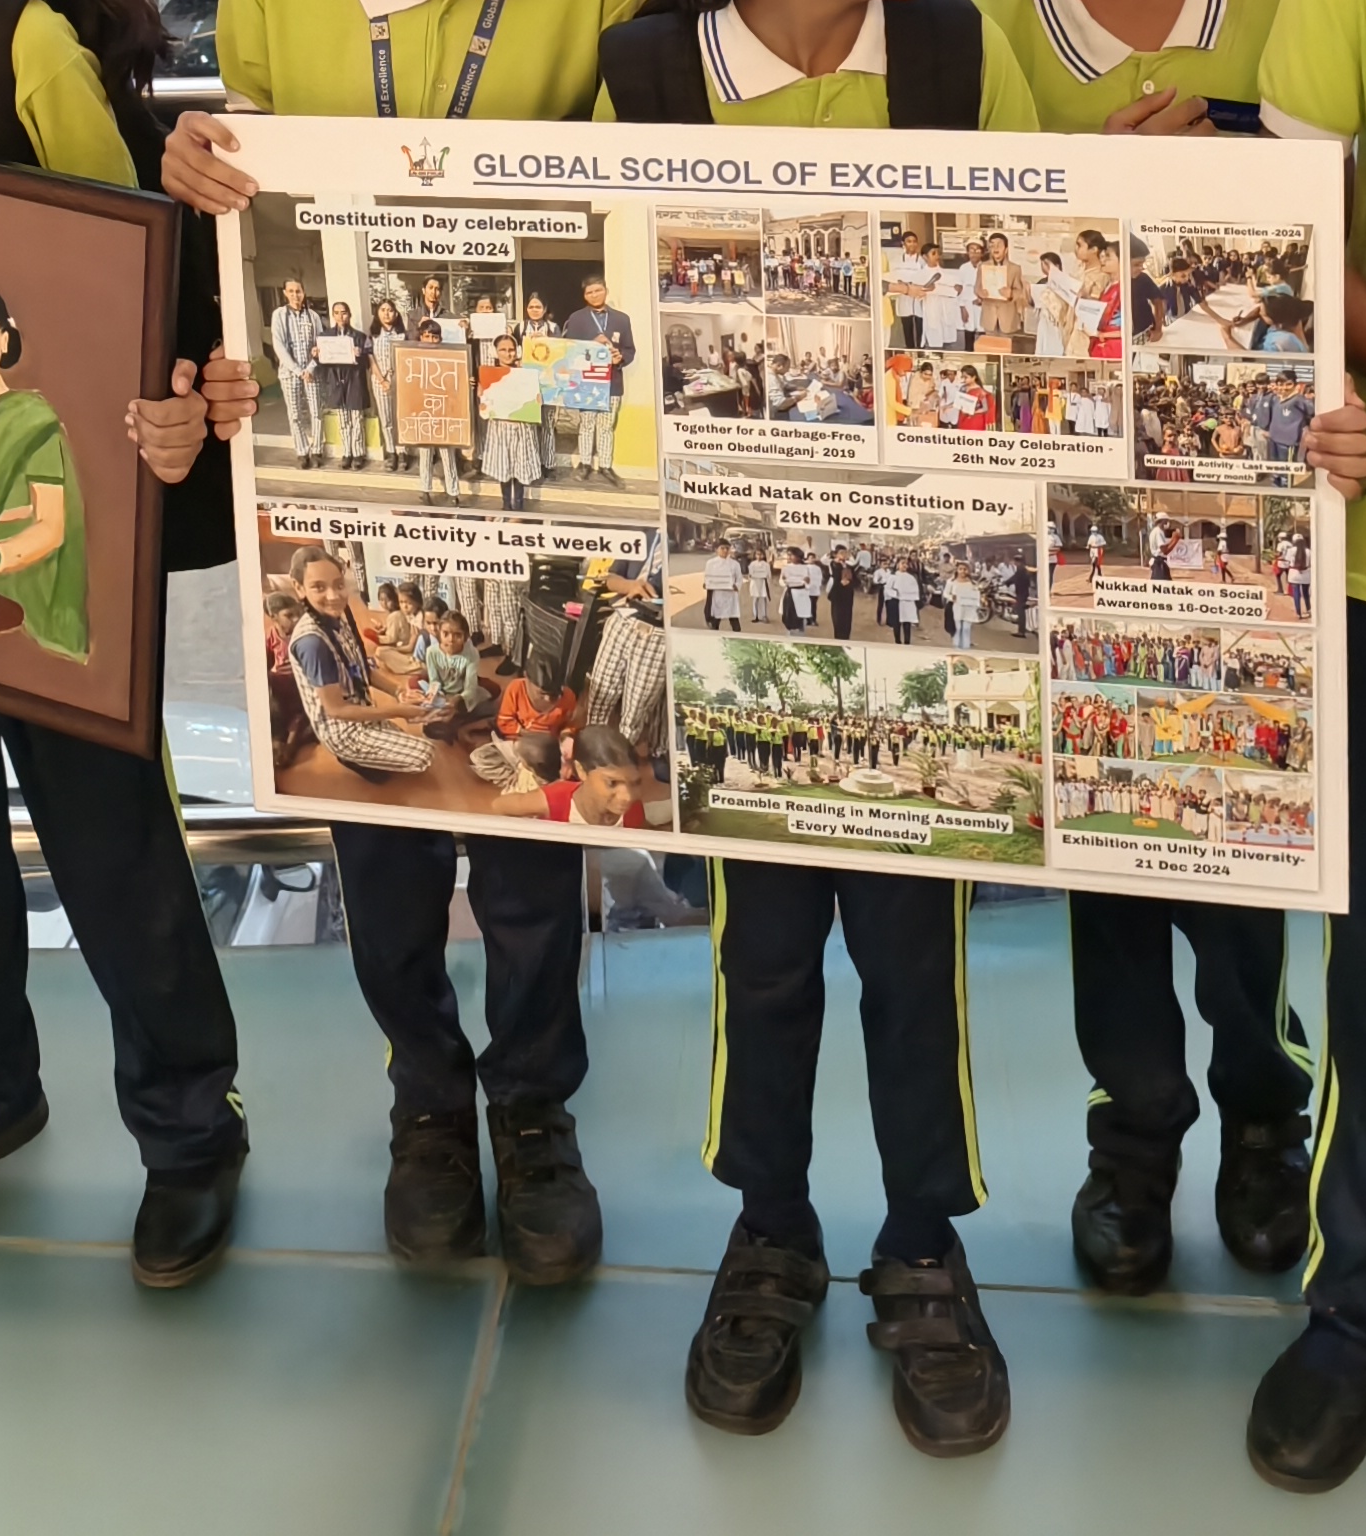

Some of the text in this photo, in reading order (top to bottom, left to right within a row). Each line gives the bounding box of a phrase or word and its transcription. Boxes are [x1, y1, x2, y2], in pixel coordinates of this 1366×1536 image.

[473, 152, 1067, 194] GLOBAL SCHOOL OF EXCELLENCE
[298, 210, 583, 234] Constitution Day celebration-
[370, 238, 510, 257] 26th Nov 2024
[404, 355, 468, 392] भारत
[422, 393, 449, 416] का
[681, 480, 1015, 518] Nukkad Natak on Constitution Day-
[778, 509, 914, 531] 26th Nov 2019
[274, 515, 322, 533] Kind
[328, 518, 387, 539] Spirit
[393, 522, 477, 548] Activity
[497, 529, 546, 548] Last
[551, 535, 612, 553] week
[619, 538, 642, 555] of
[389, 554, 525, 576] every month
[709, 793, 1013, 836] Preamble Reading in Morning Assembly
[1061, 833, 1305, 867] Exhibition on Unity in Diversity-
[1134, 857, 1231, 876] 21 Dec 2024
